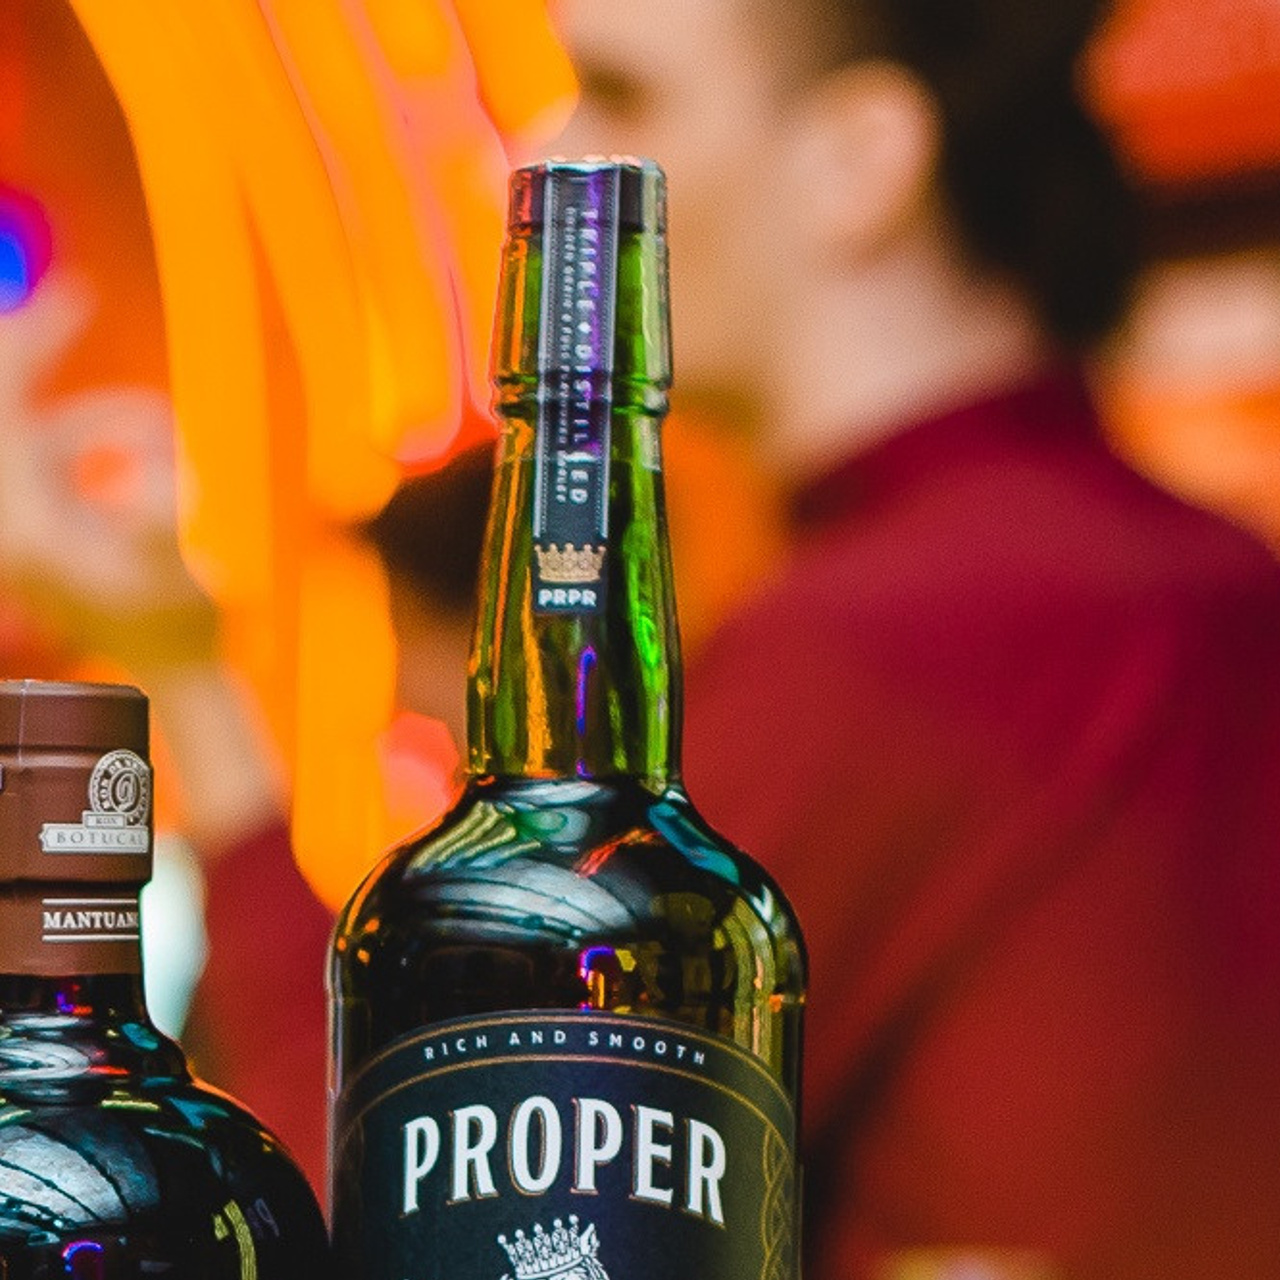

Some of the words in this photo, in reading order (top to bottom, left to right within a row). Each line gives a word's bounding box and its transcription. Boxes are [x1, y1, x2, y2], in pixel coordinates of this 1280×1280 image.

[577, 208, 599, 312] TRIPLE
[537, 589, 597, 607] PRPR
[43, 912, 139, 930] MANTUAN
[424, 1035, 488, 1060] RICH
[509, 1029, 566, 1046] AND
[588, 1030, 705, 1065] SMOOTH
[400, 1096, 726, 1229] PROPER
